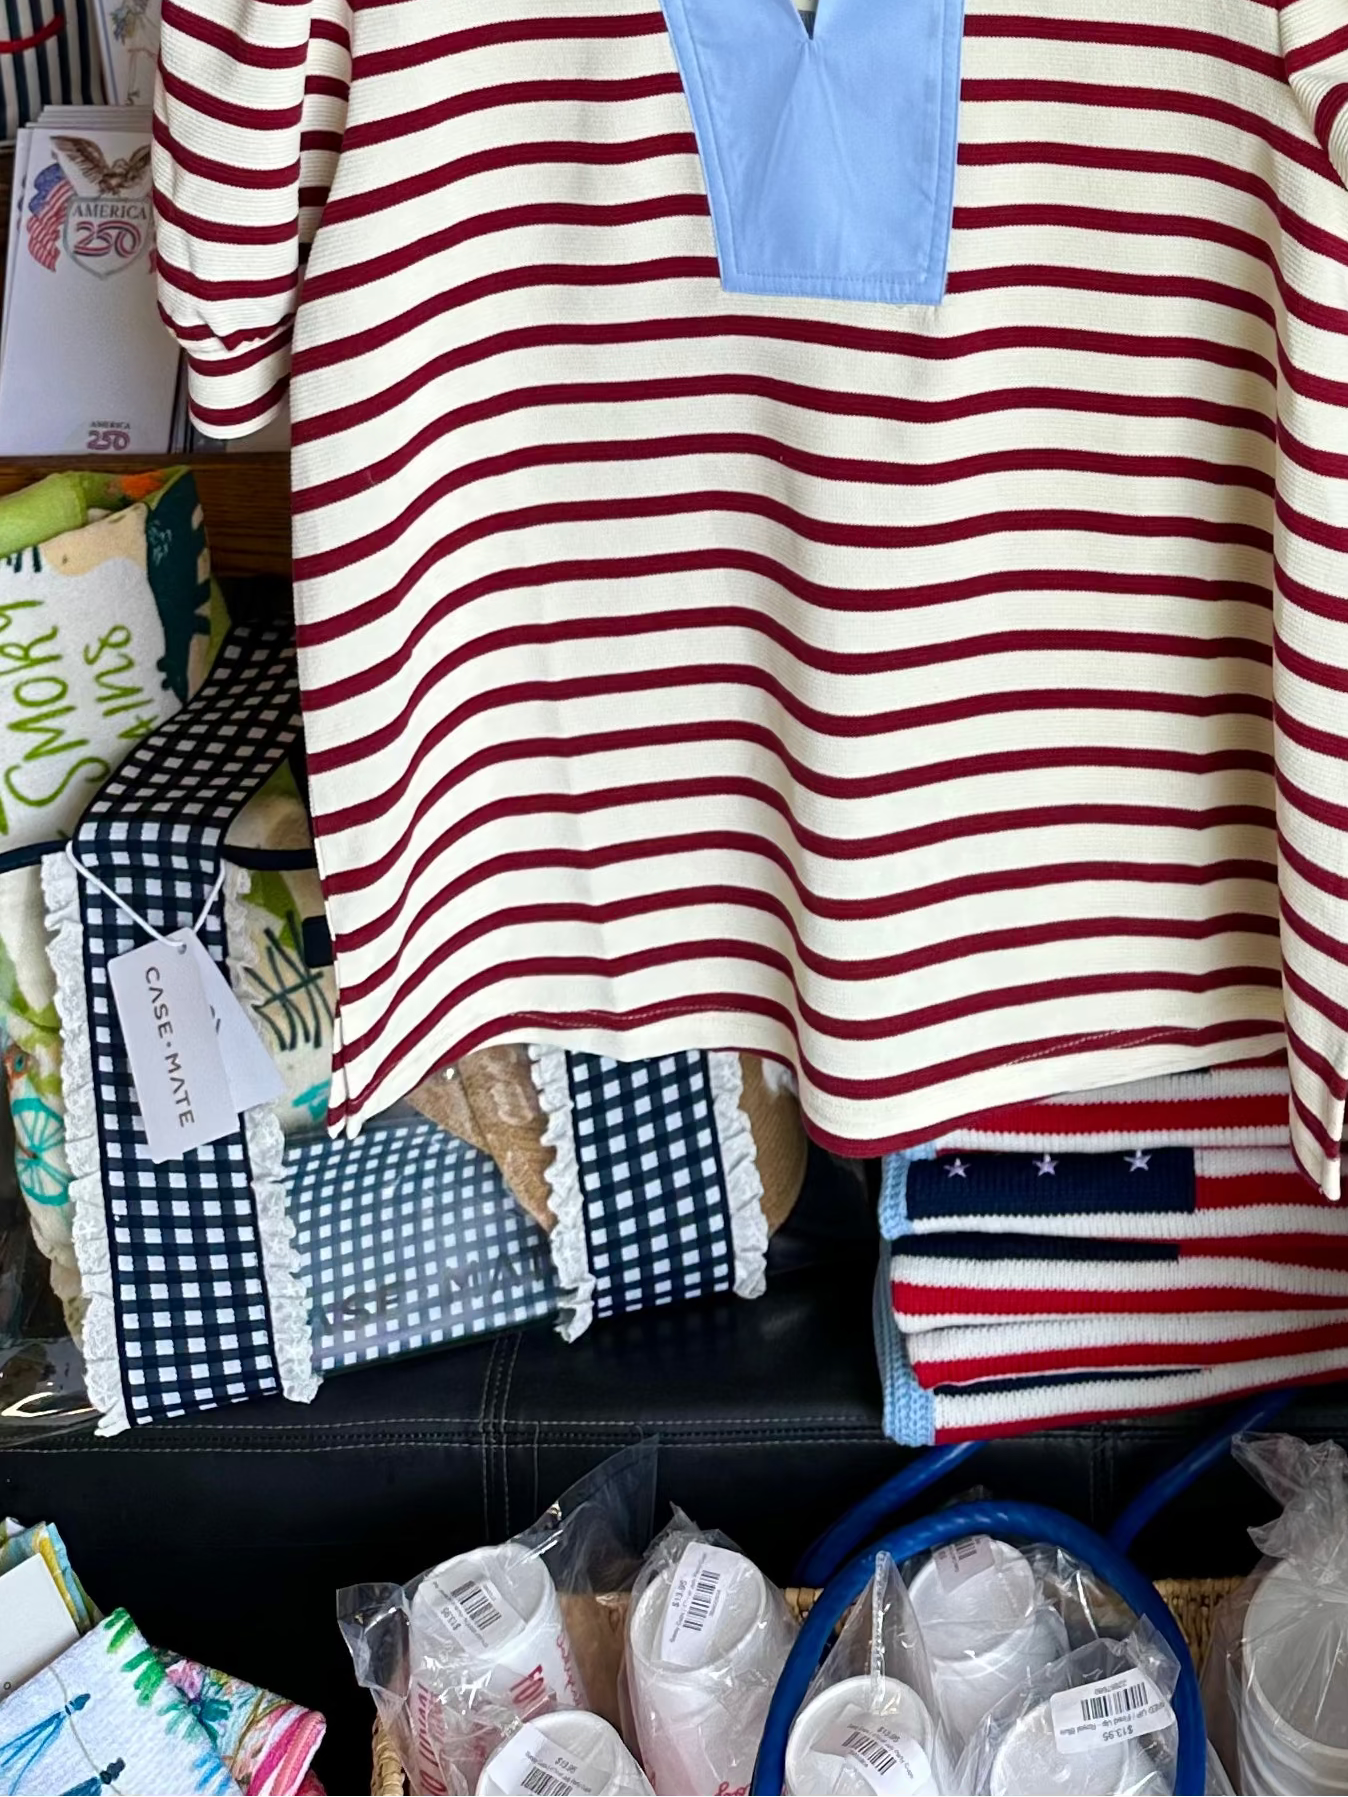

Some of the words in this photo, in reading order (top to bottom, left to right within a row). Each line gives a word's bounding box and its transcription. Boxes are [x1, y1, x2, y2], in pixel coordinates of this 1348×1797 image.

[72, 203, 147, 220] AMERICA
[73, 220, 141, 258] 250
[86, 429, 131, 451] 250
[1102, 1724, 1134, 1742] $13.95
